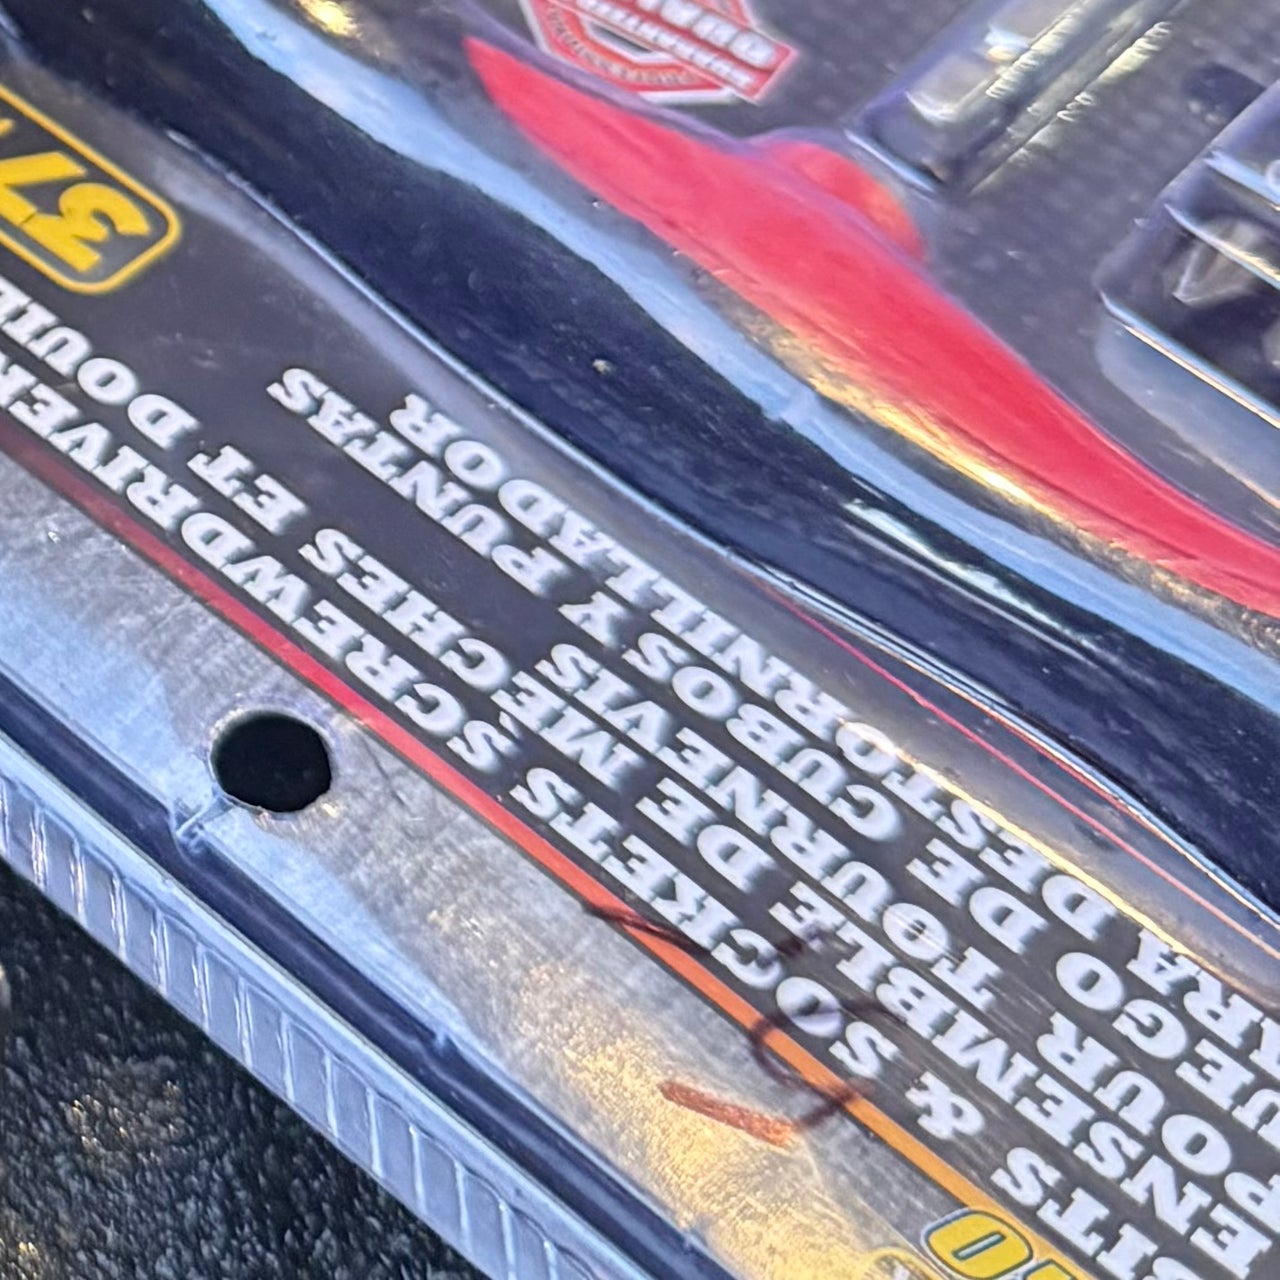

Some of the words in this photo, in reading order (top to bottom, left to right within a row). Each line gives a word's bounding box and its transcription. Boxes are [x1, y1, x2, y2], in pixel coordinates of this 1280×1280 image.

[187, 444, 308, 537] ET
[266, 367, 570, 599] PUNTAS
[298, 528, 643, 790] MÈCHES
[389, 392, 1119, 942] DESTORNILLADOR
[558, 590, 634, 649] Y
[535, 643, 1003, 1012] TOURNEVIS
[622, 632, 902, 838] CUBOS
[636, 778, 777, 893] DE
[510, 768, 900, 1079] SOCKETS
[906, 837, 1050, 954] DE
[768, 881, 1272, 1279] ENSEMBLE
[905, 1071, 986, 1139] &
[1037, 1012, 1280, 1233] POUR
[1056, 952, 1280, 1151] UEGO
